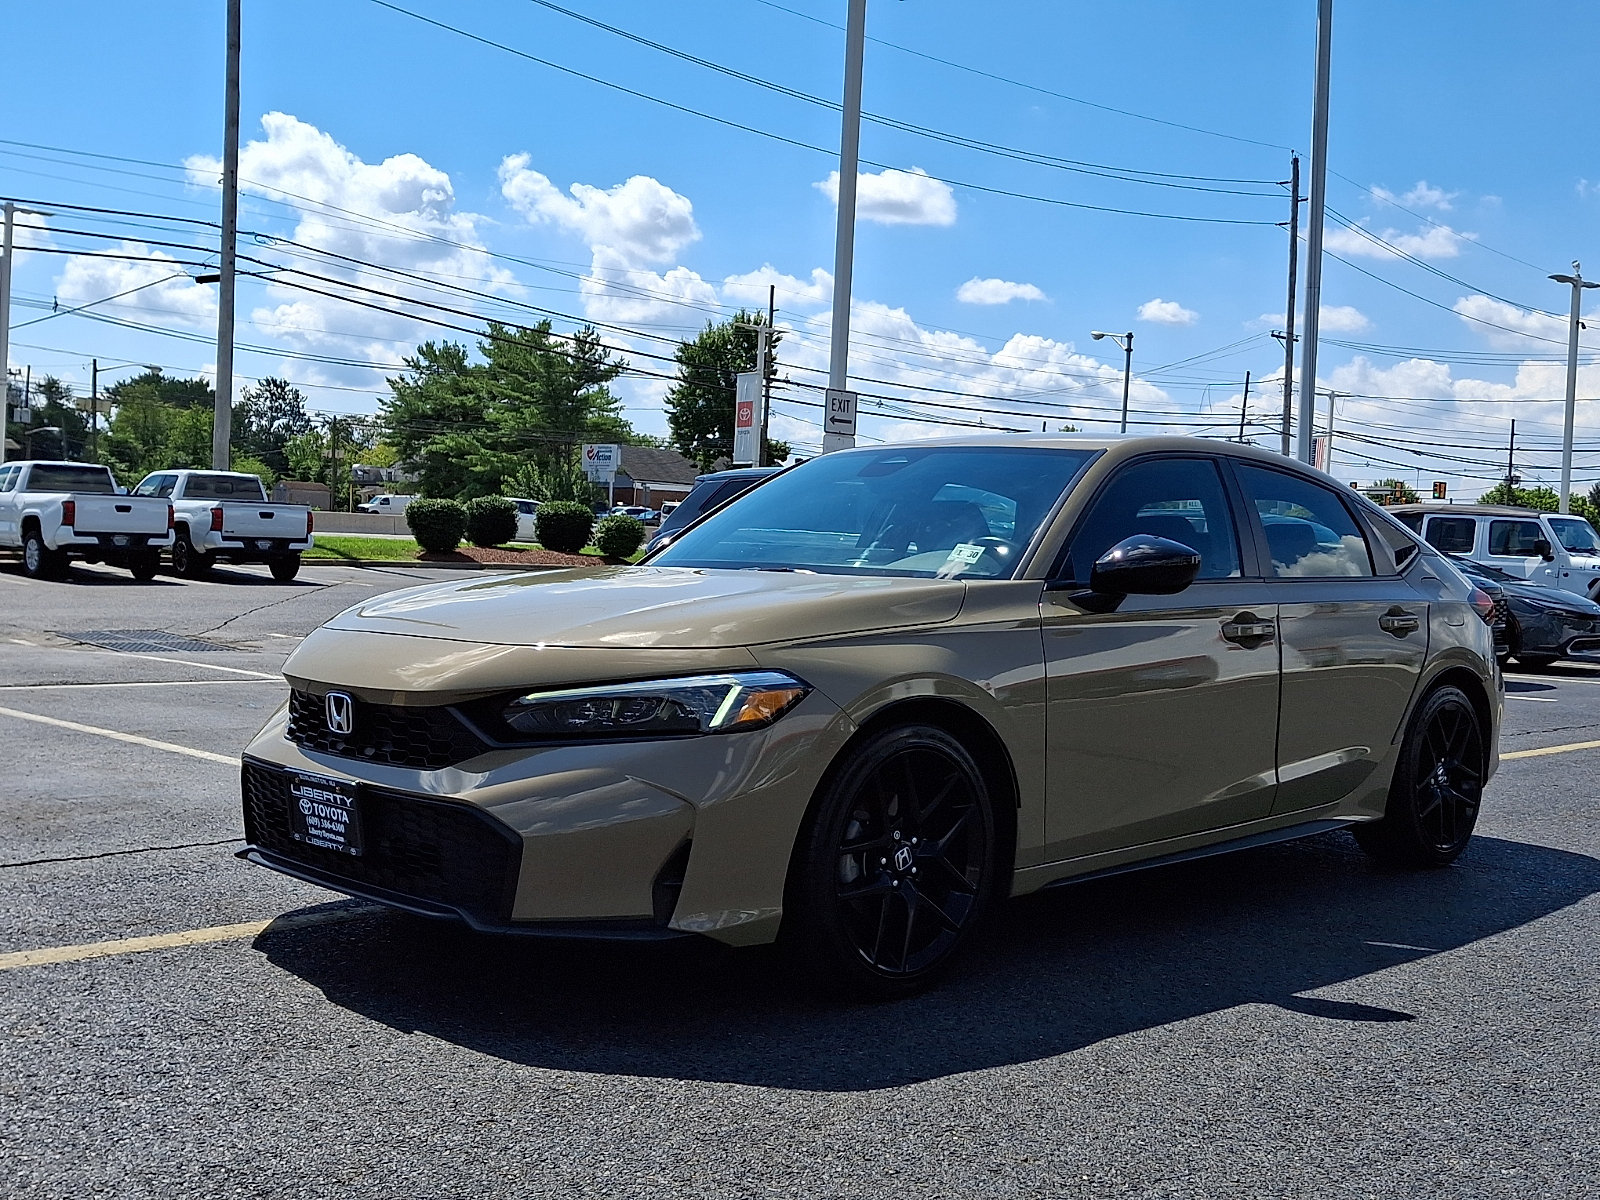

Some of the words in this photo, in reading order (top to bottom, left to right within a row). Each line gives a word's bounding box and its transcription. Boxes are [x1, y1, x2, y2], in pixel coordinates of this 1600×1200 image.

[831, 397, 850, 413] EXIT
[592, 449, 612, 461] Action
[290, 783, 354, 807] LIBERTY
[312, 802, 350, 824] TOYOTA
[305, 815, 321, 828] (609)
[305, 835, 344, 852] LIBERTY
